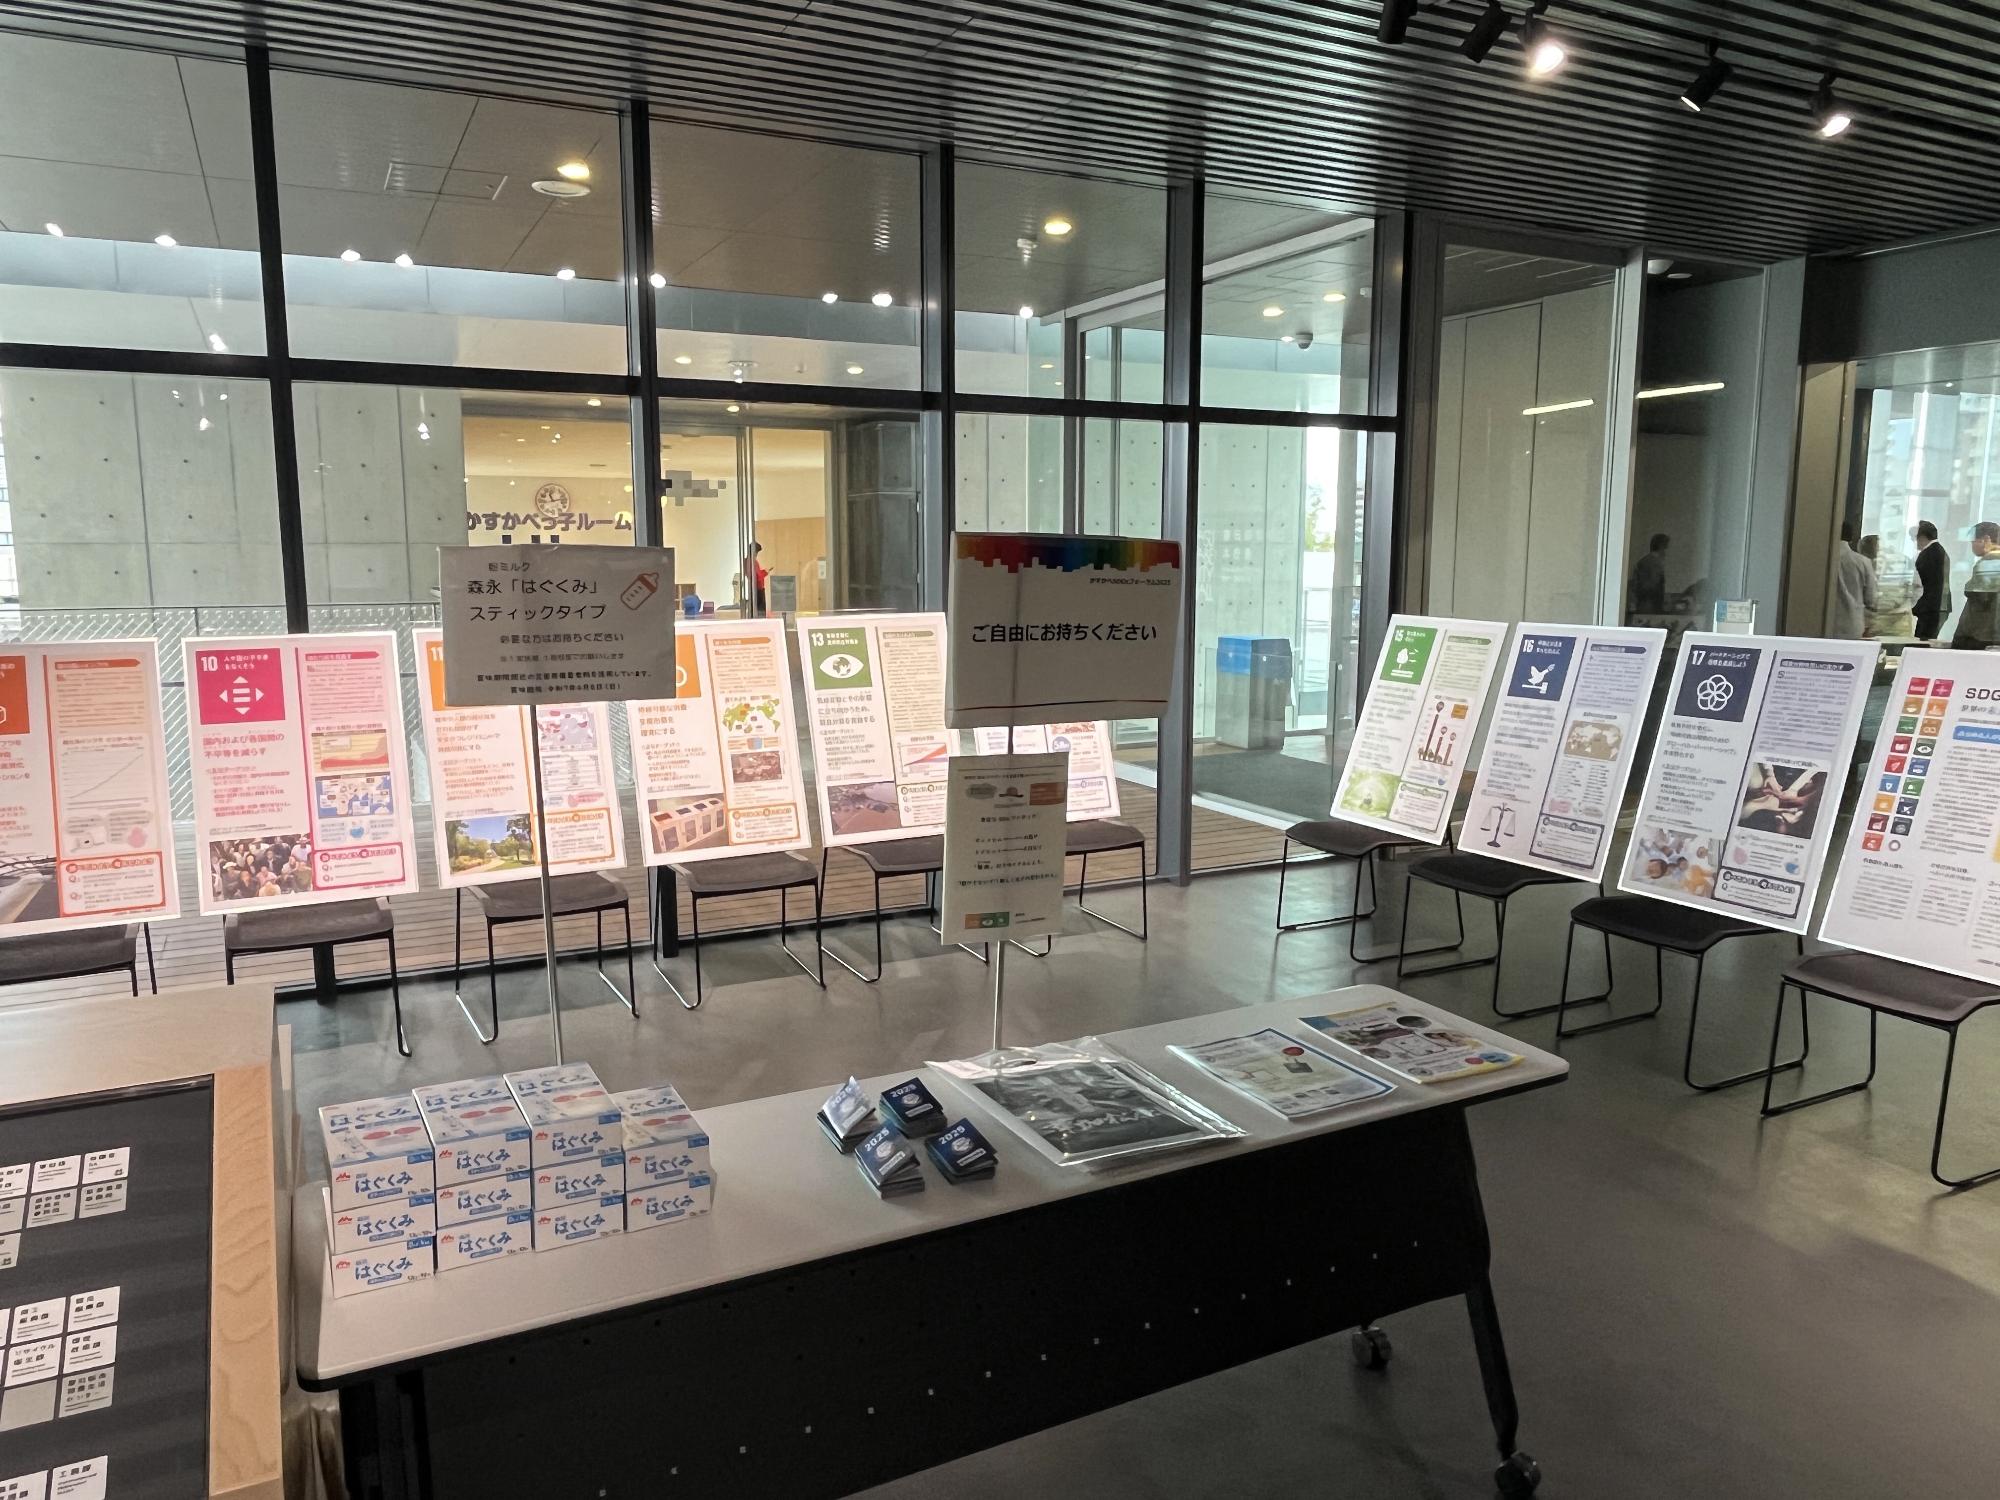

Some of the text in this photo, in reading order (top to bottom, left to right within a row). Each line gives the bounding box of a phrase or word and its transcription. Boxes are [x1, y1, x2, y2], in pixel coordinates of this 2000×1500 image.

[467, 511, 632, 531] かすかべっ子ルーム
[467, 579, 599, 594] 森永「はぐくみ」
[470, 604, 607, 622] スティックタイプ
[811, 632, 825, 647] 13
[972, 623, 1157, 643] ご自由にお持ちください
[1522, 639, 1535, 653] 16
[201, 655, 218, 672] 10
[1691, 650, 1707, 666] 17
[864, 1127, 891, 1152] 2025
[938, 1126, 966, 1145] 2025
[457, 1148, 511, 1169] はぐくみ
[355, 1171, 414, 1194] はぐくみ
[555, 1173, 607, 1194] はぐくみ
[458, 1188, 512, 1209] はぐくみ
[357, 1214, 415, 1236] はぐくみ
[555, 1213, 606, 1235] はぐくみ
[458, 1231, 512, 1254] はぐくみ
[355, 1256, 413, 1280] はぐくみ
